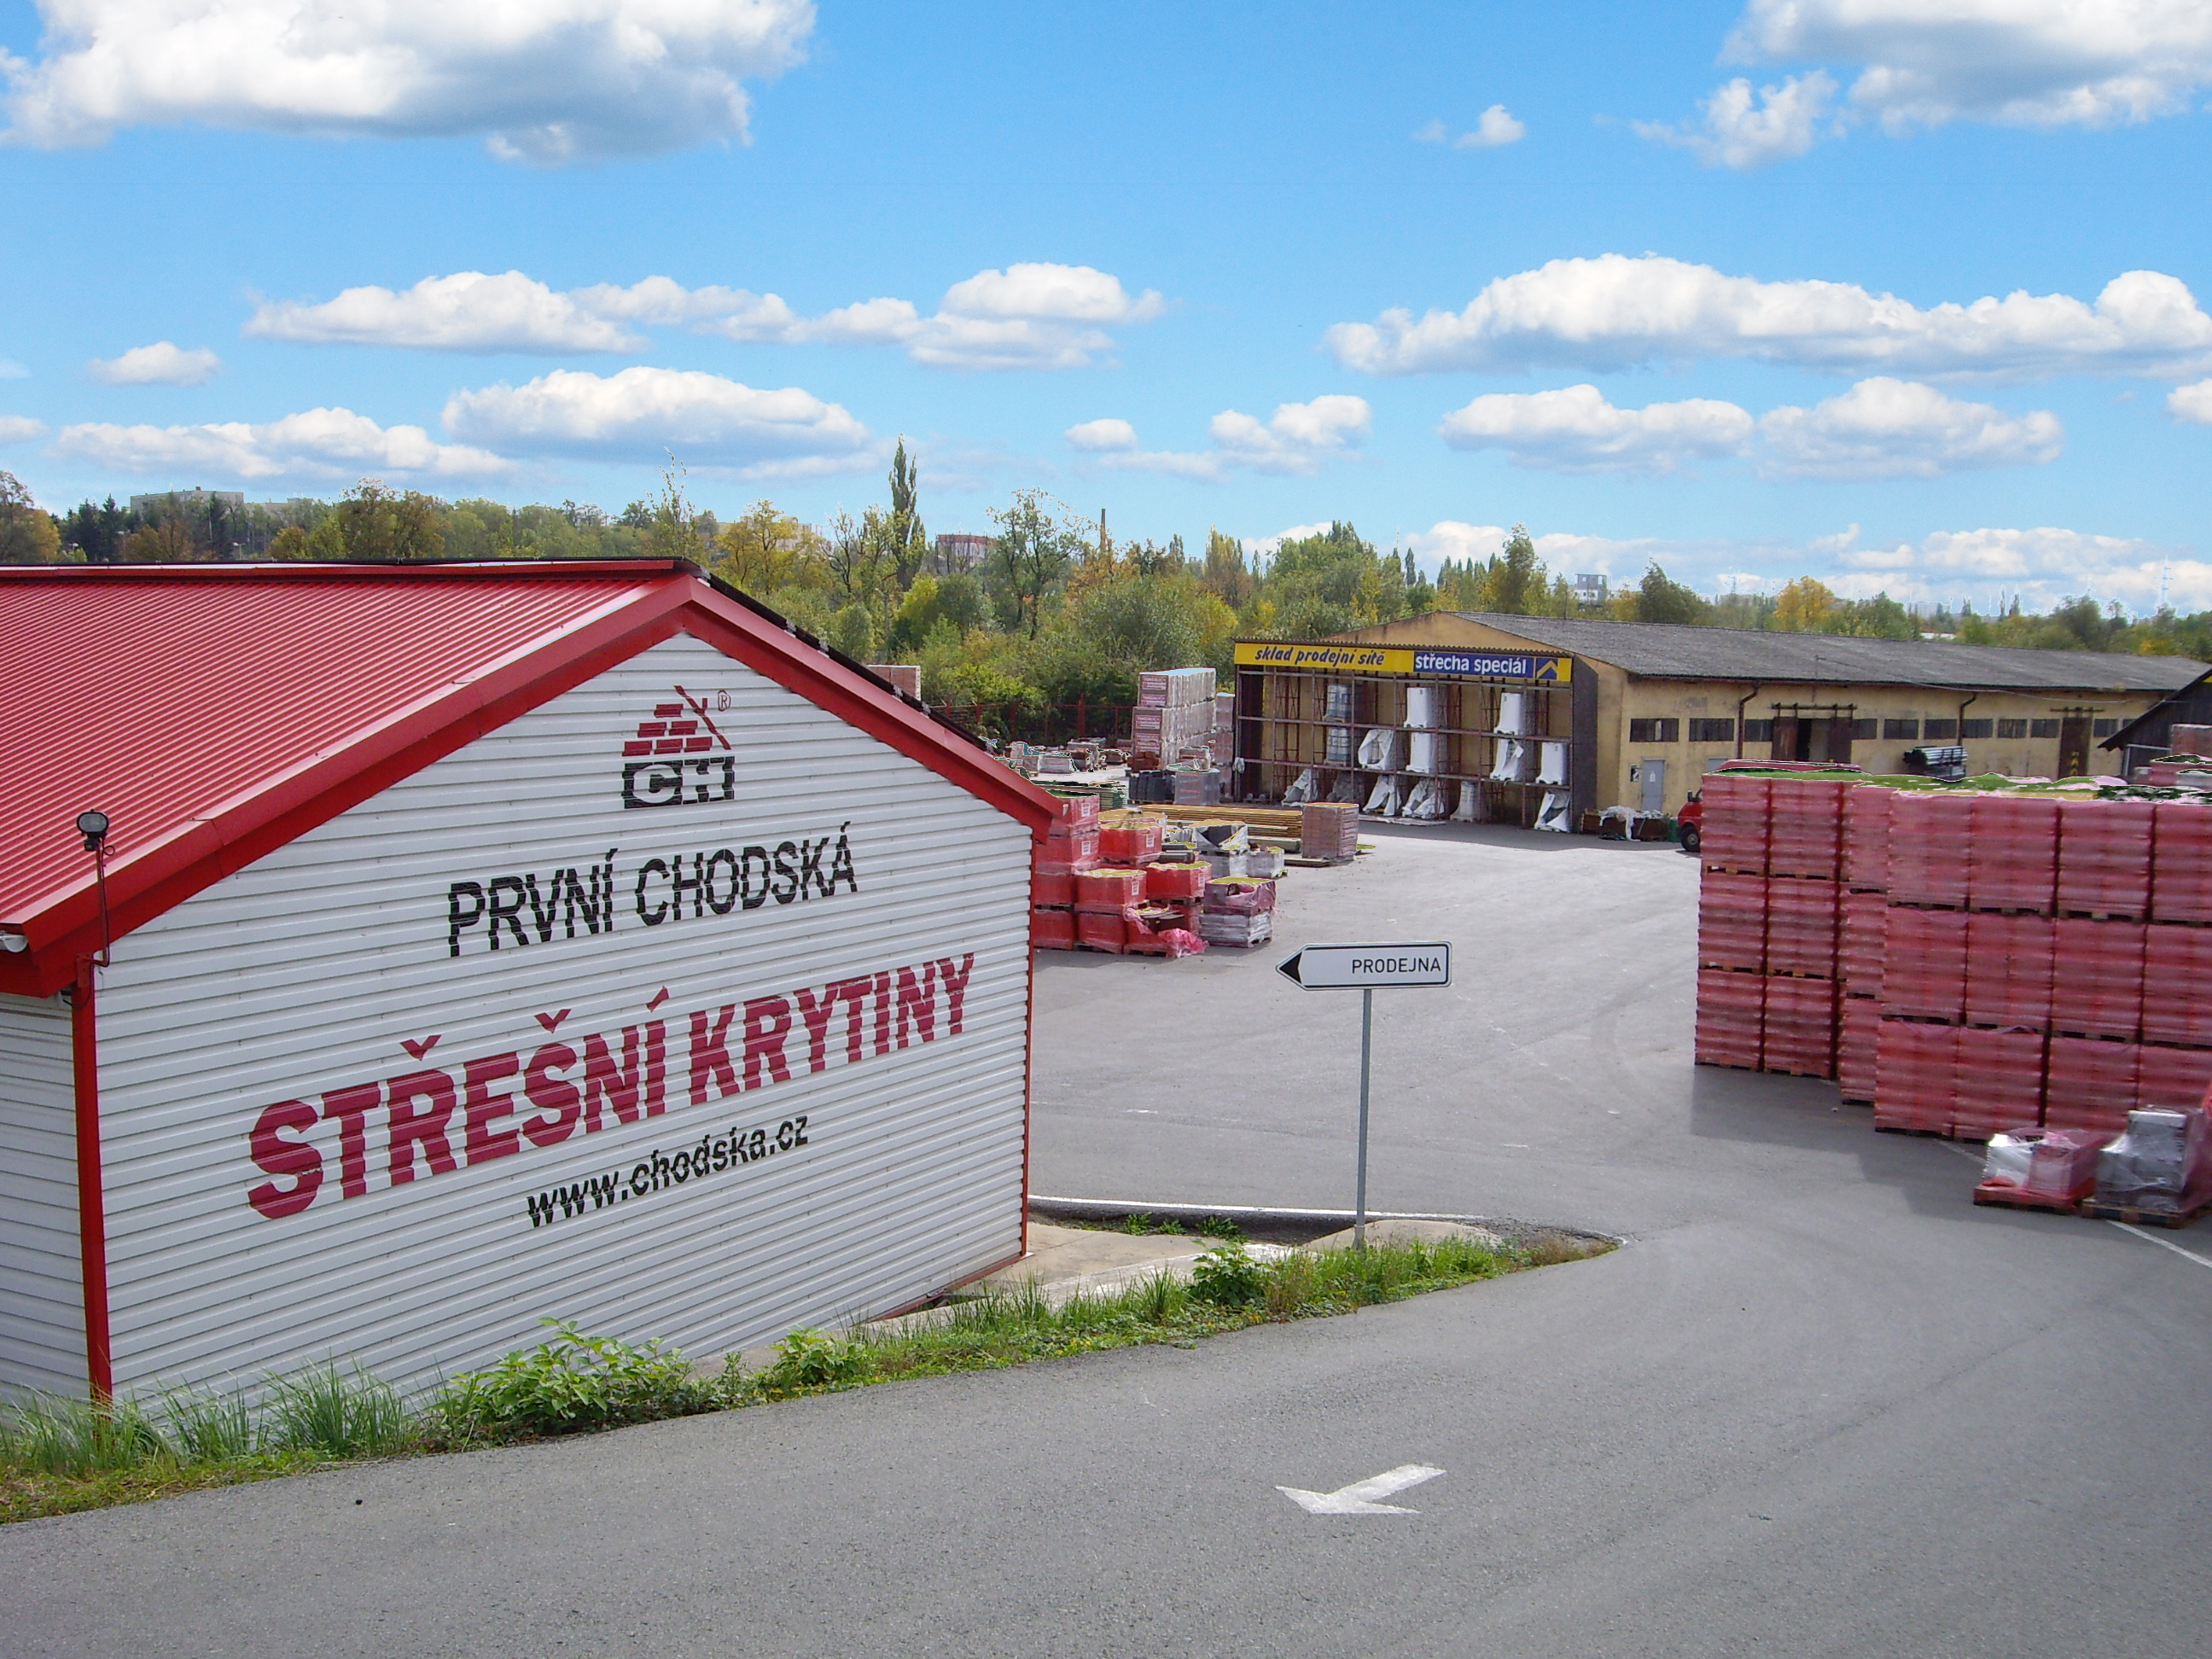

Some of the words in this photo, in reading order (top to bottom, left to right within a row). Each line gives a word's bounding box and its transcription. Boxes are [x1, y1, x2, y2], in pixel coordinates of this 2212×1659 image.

[1254, 645, 1294, 661] sklad
[1295, 648, 1357, 667] prodejní
[1358, 649, 1386, 666] sítě
[1415, 653, 1470, 671] střecha
[1474, 657, 1527, 675] speciál
[448, 847, 619, 958] PRVNÍ
[635, 821, 858, 927] CHODSKÁ
[1352, 958, 1441, 974] PRODEJNA
[247, 986, 670, 1220] STŘEŠNÍ
[687, 953, 975, 1107] KRYTINY
[526, 1115, 808, 1228] www.chodska.cz
